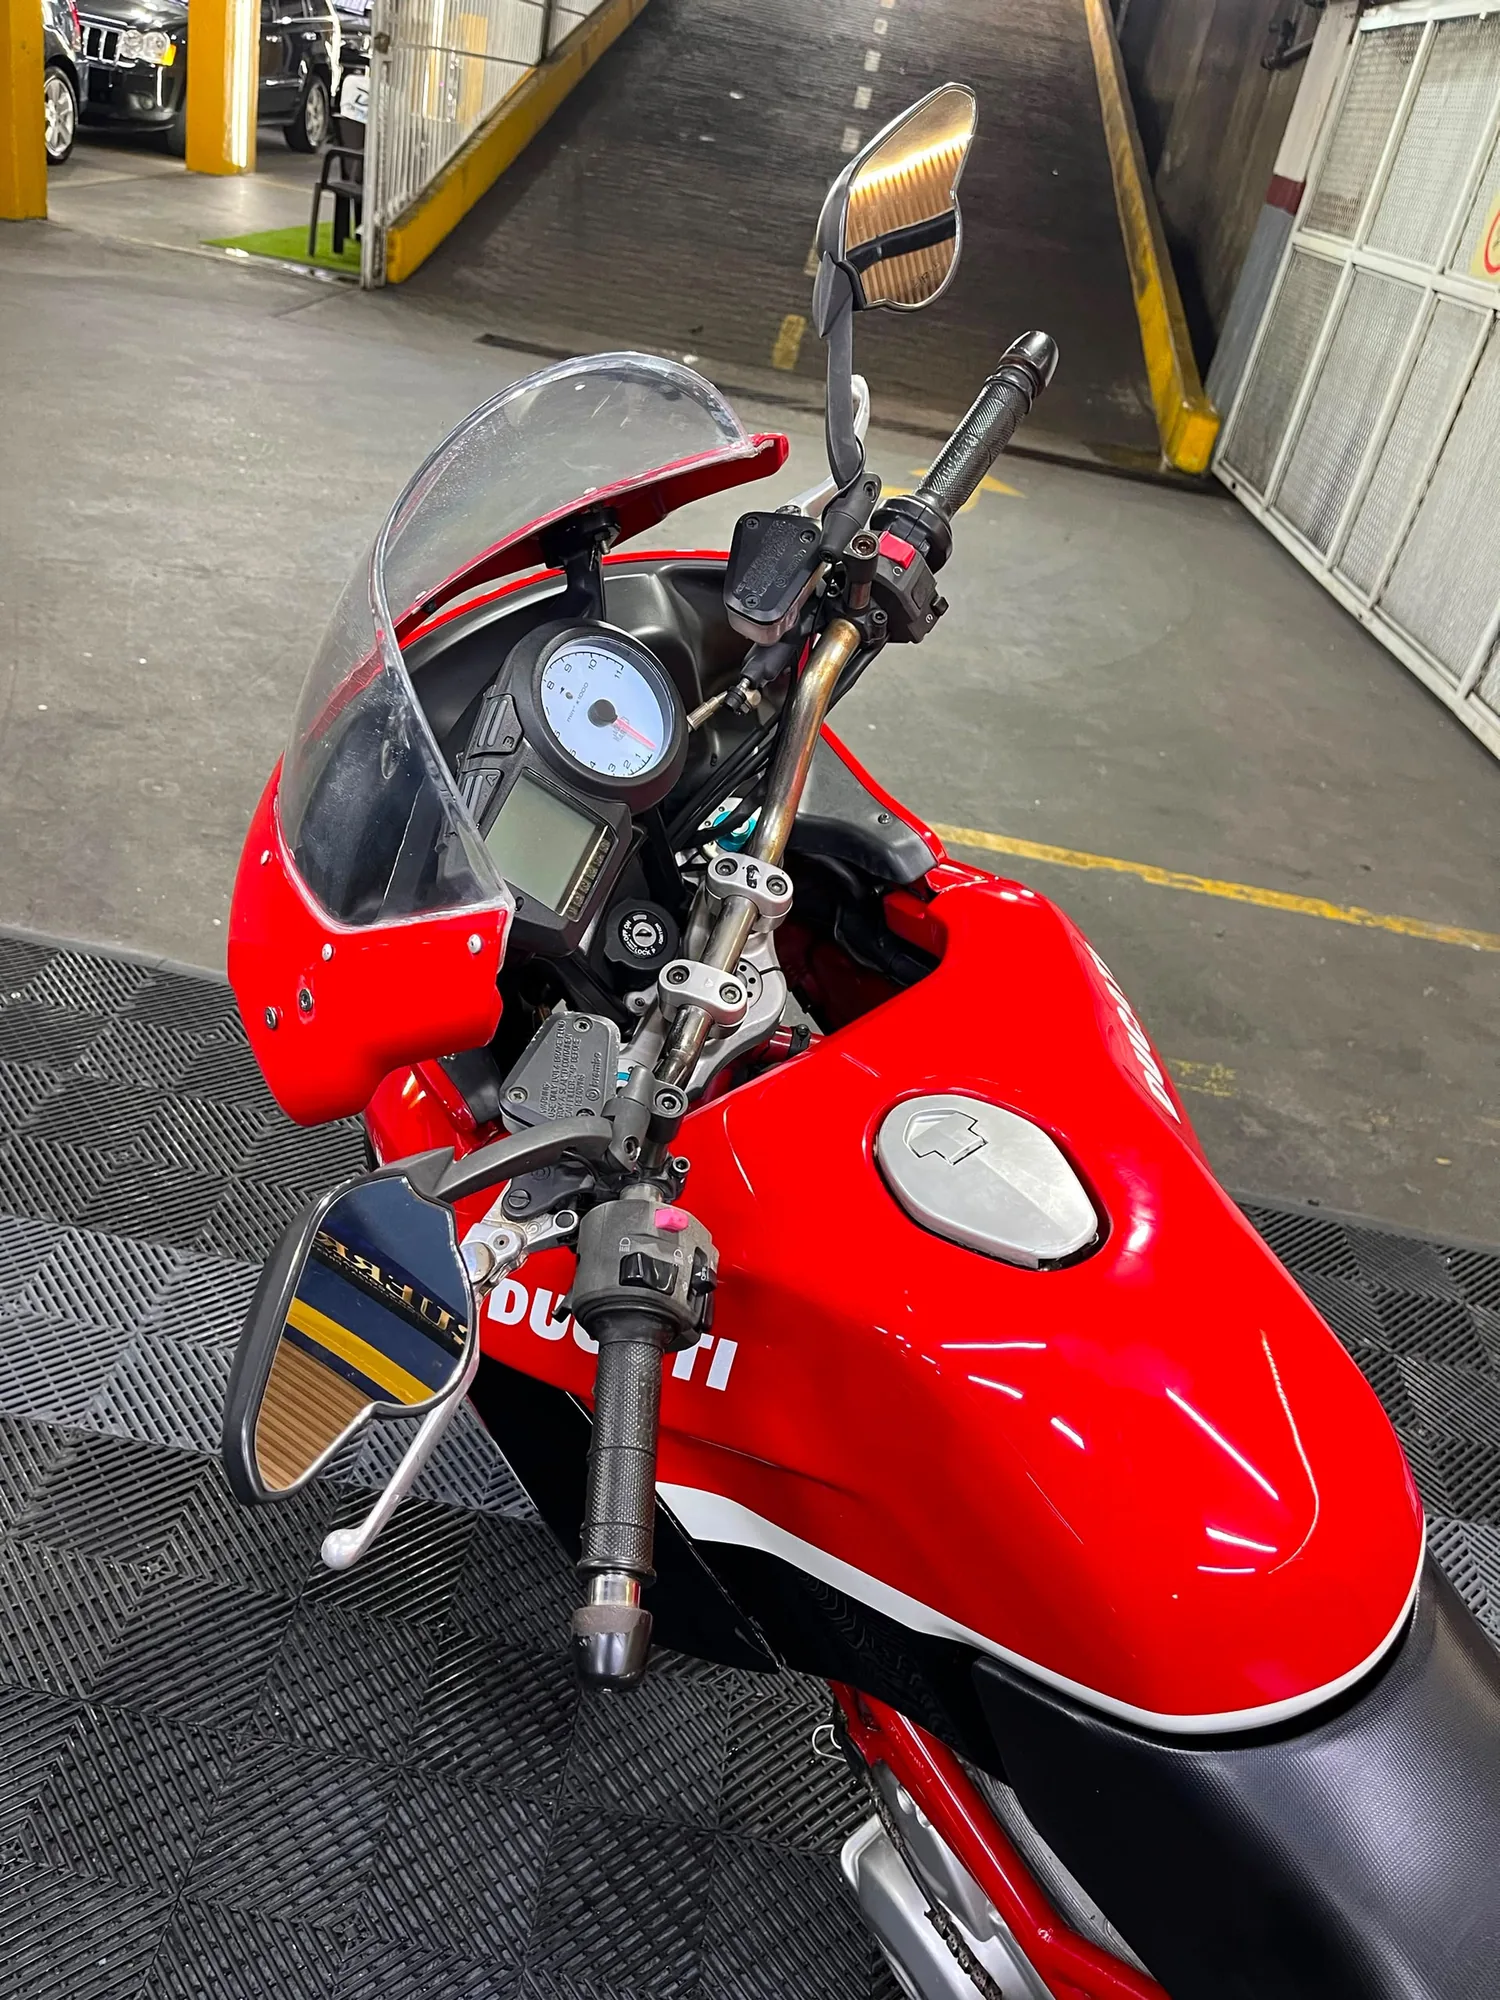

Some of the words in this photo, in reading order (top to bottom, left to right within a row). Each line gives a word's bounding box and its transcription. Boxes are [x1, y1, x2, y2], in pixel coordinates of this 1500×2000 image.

[564, 663, 573, 673] 9
[588, 659, 598, 671] 10
[614, 670, 622, 679] 11
[546, 680, 555, 690] 8
[503, 735, 514, 748] B
[589, 760, 597, 768] 4
[608, 763, 617, 772] 3
[622, 759, 632, 769] 2
[485, 773, 499, 787] A
[488, 1278, 738, 1392] DUTI
